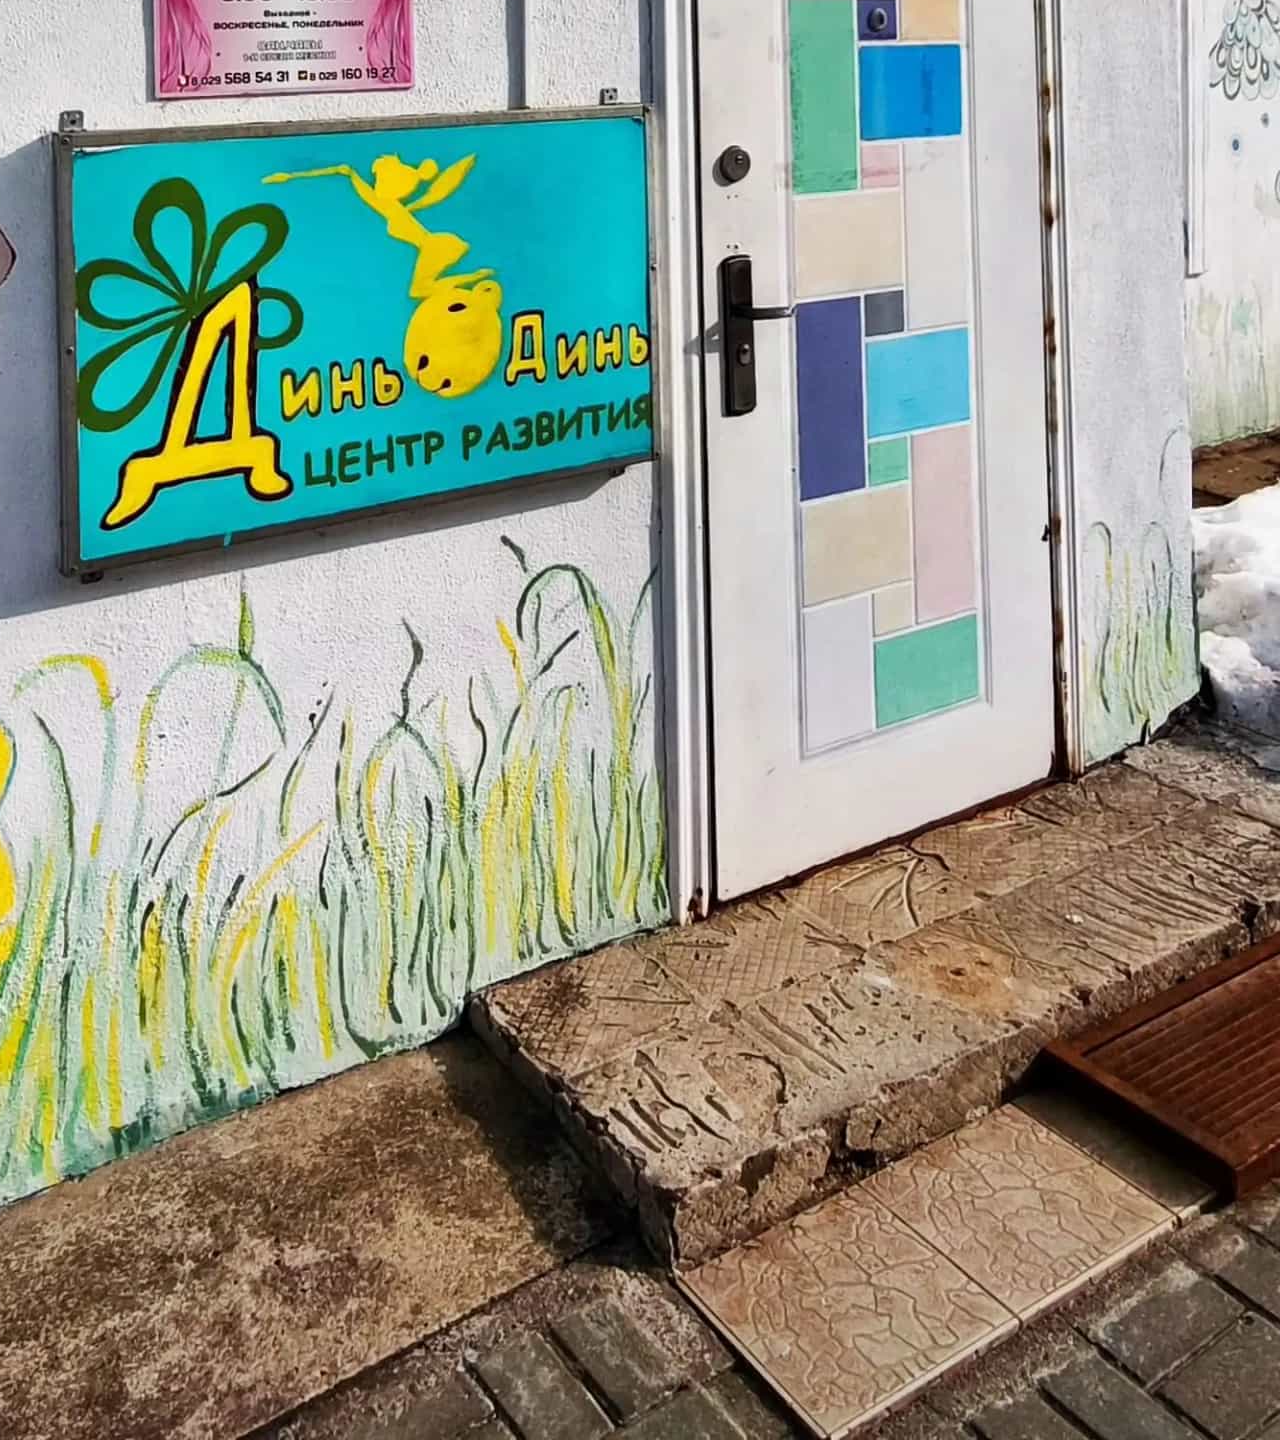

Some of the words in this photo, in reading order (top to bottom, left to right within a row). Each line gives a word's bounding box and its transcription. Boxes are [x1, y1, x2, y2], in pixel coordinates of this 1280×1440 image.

[224, 72, 251, 85] 568
[255, 71, 272, 84] 54
[276, 71, 290, 83] 31
[318, 72, 338, 81] 029
[341, 68, 362, 80] 160
[365, 67, 379, 79] 19
[100, 274, 404, 532] Динь
[504, 309, 651, 387] Динь
[302, 430, 446, 488] ЦЕНТР
[461, 393, 653, 461] РАЗВИТИЯ
